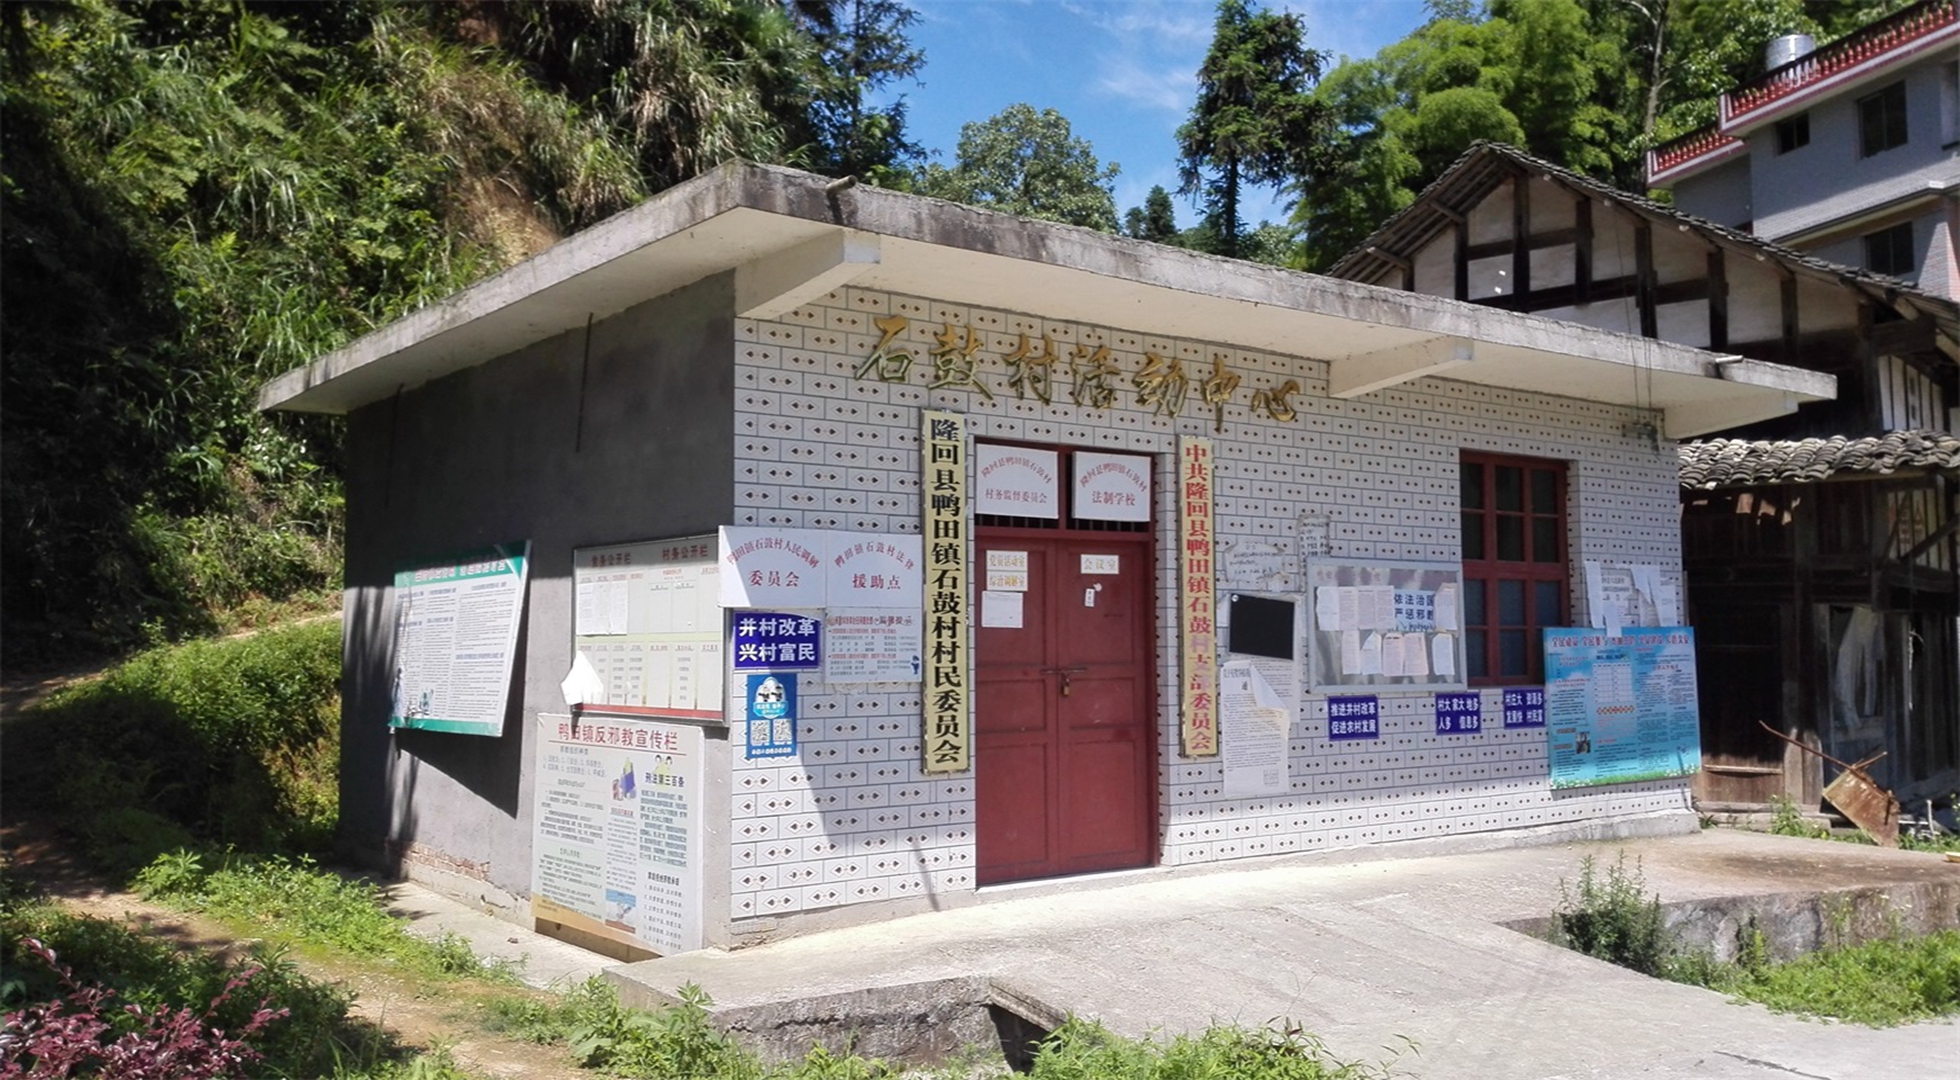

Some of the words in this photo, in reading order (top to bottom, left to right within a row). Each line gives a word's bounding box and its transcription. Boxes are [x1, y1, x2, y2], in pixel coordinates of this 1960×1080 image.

[855, 315, 1299, 434] 石鼓村活动中心
[981, 456, 1052, 485] 隆回县鸭田镇石鼓村
[1079, 462, 1148, 493] 隆回县鸭田镇石鼓村
[985, 488, 1048, 504] 村务监督委员会
[1091, 490, 1136, 506] 法制学校
[661, 543, 709, 562] 村务公开栏
[726, 537, 820, 569] 鸭田镇石鼓村人民调解
[834, 541, 915, 571] 鸭田镇石鼓村法律
[1083, 557, 1117, 571] 会议室
[748, 569, 800, 588] 委员会
[852, 573, 902, 591] 援助点
[930, 418, 962, 764] 隆回县鸭田镇石鼓村村民委员会
[1185, 444, 1212, 750] 中共隆回县鸭田镇石鼓村支部委员会
[738, 617, 816, 637] 并村改革
[738, 642, 816, 662] 兴村富民
[1330, 702, 1376, 716] 推进并村改革
[1331, 719, 1376, 734] 促进农村发展
[1438, 716, 1451, 730] 人多
[558, 723, 678, 751] 鸭田镇反邪教宣传栏
[644, 772, 685, 788] 刑法第三百条
